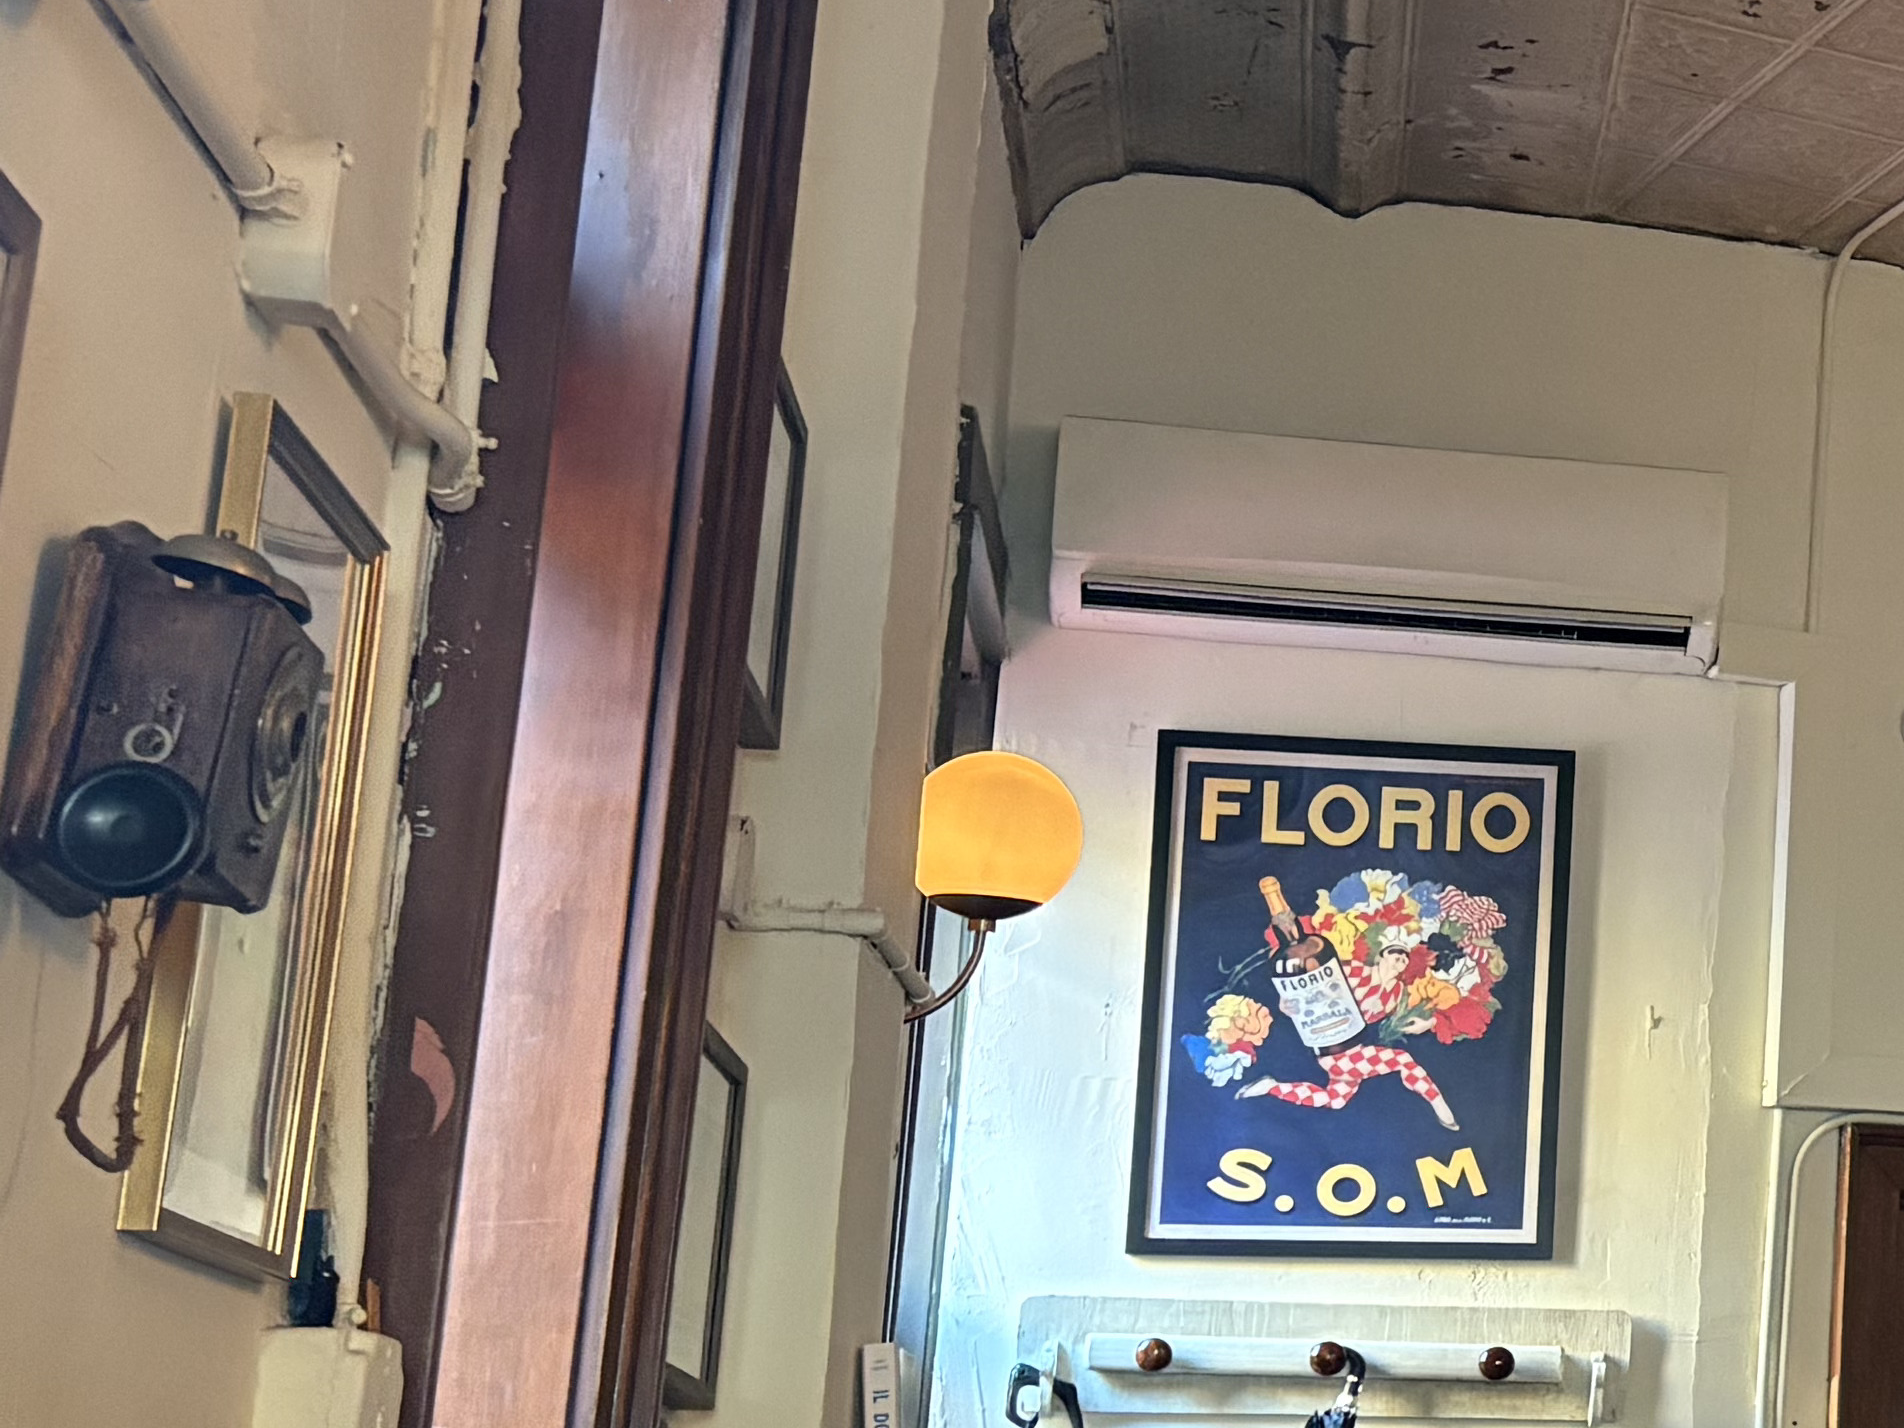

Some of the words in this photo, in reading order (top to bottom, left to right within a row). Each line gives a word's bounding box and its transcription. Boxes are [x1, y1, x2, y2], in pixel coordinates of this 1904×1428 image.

[1199, 777, 1531, 853] FLORIO
[1280, 966, 1333, 992] FLORIO
[872, 1389, 890, 1404] IL
